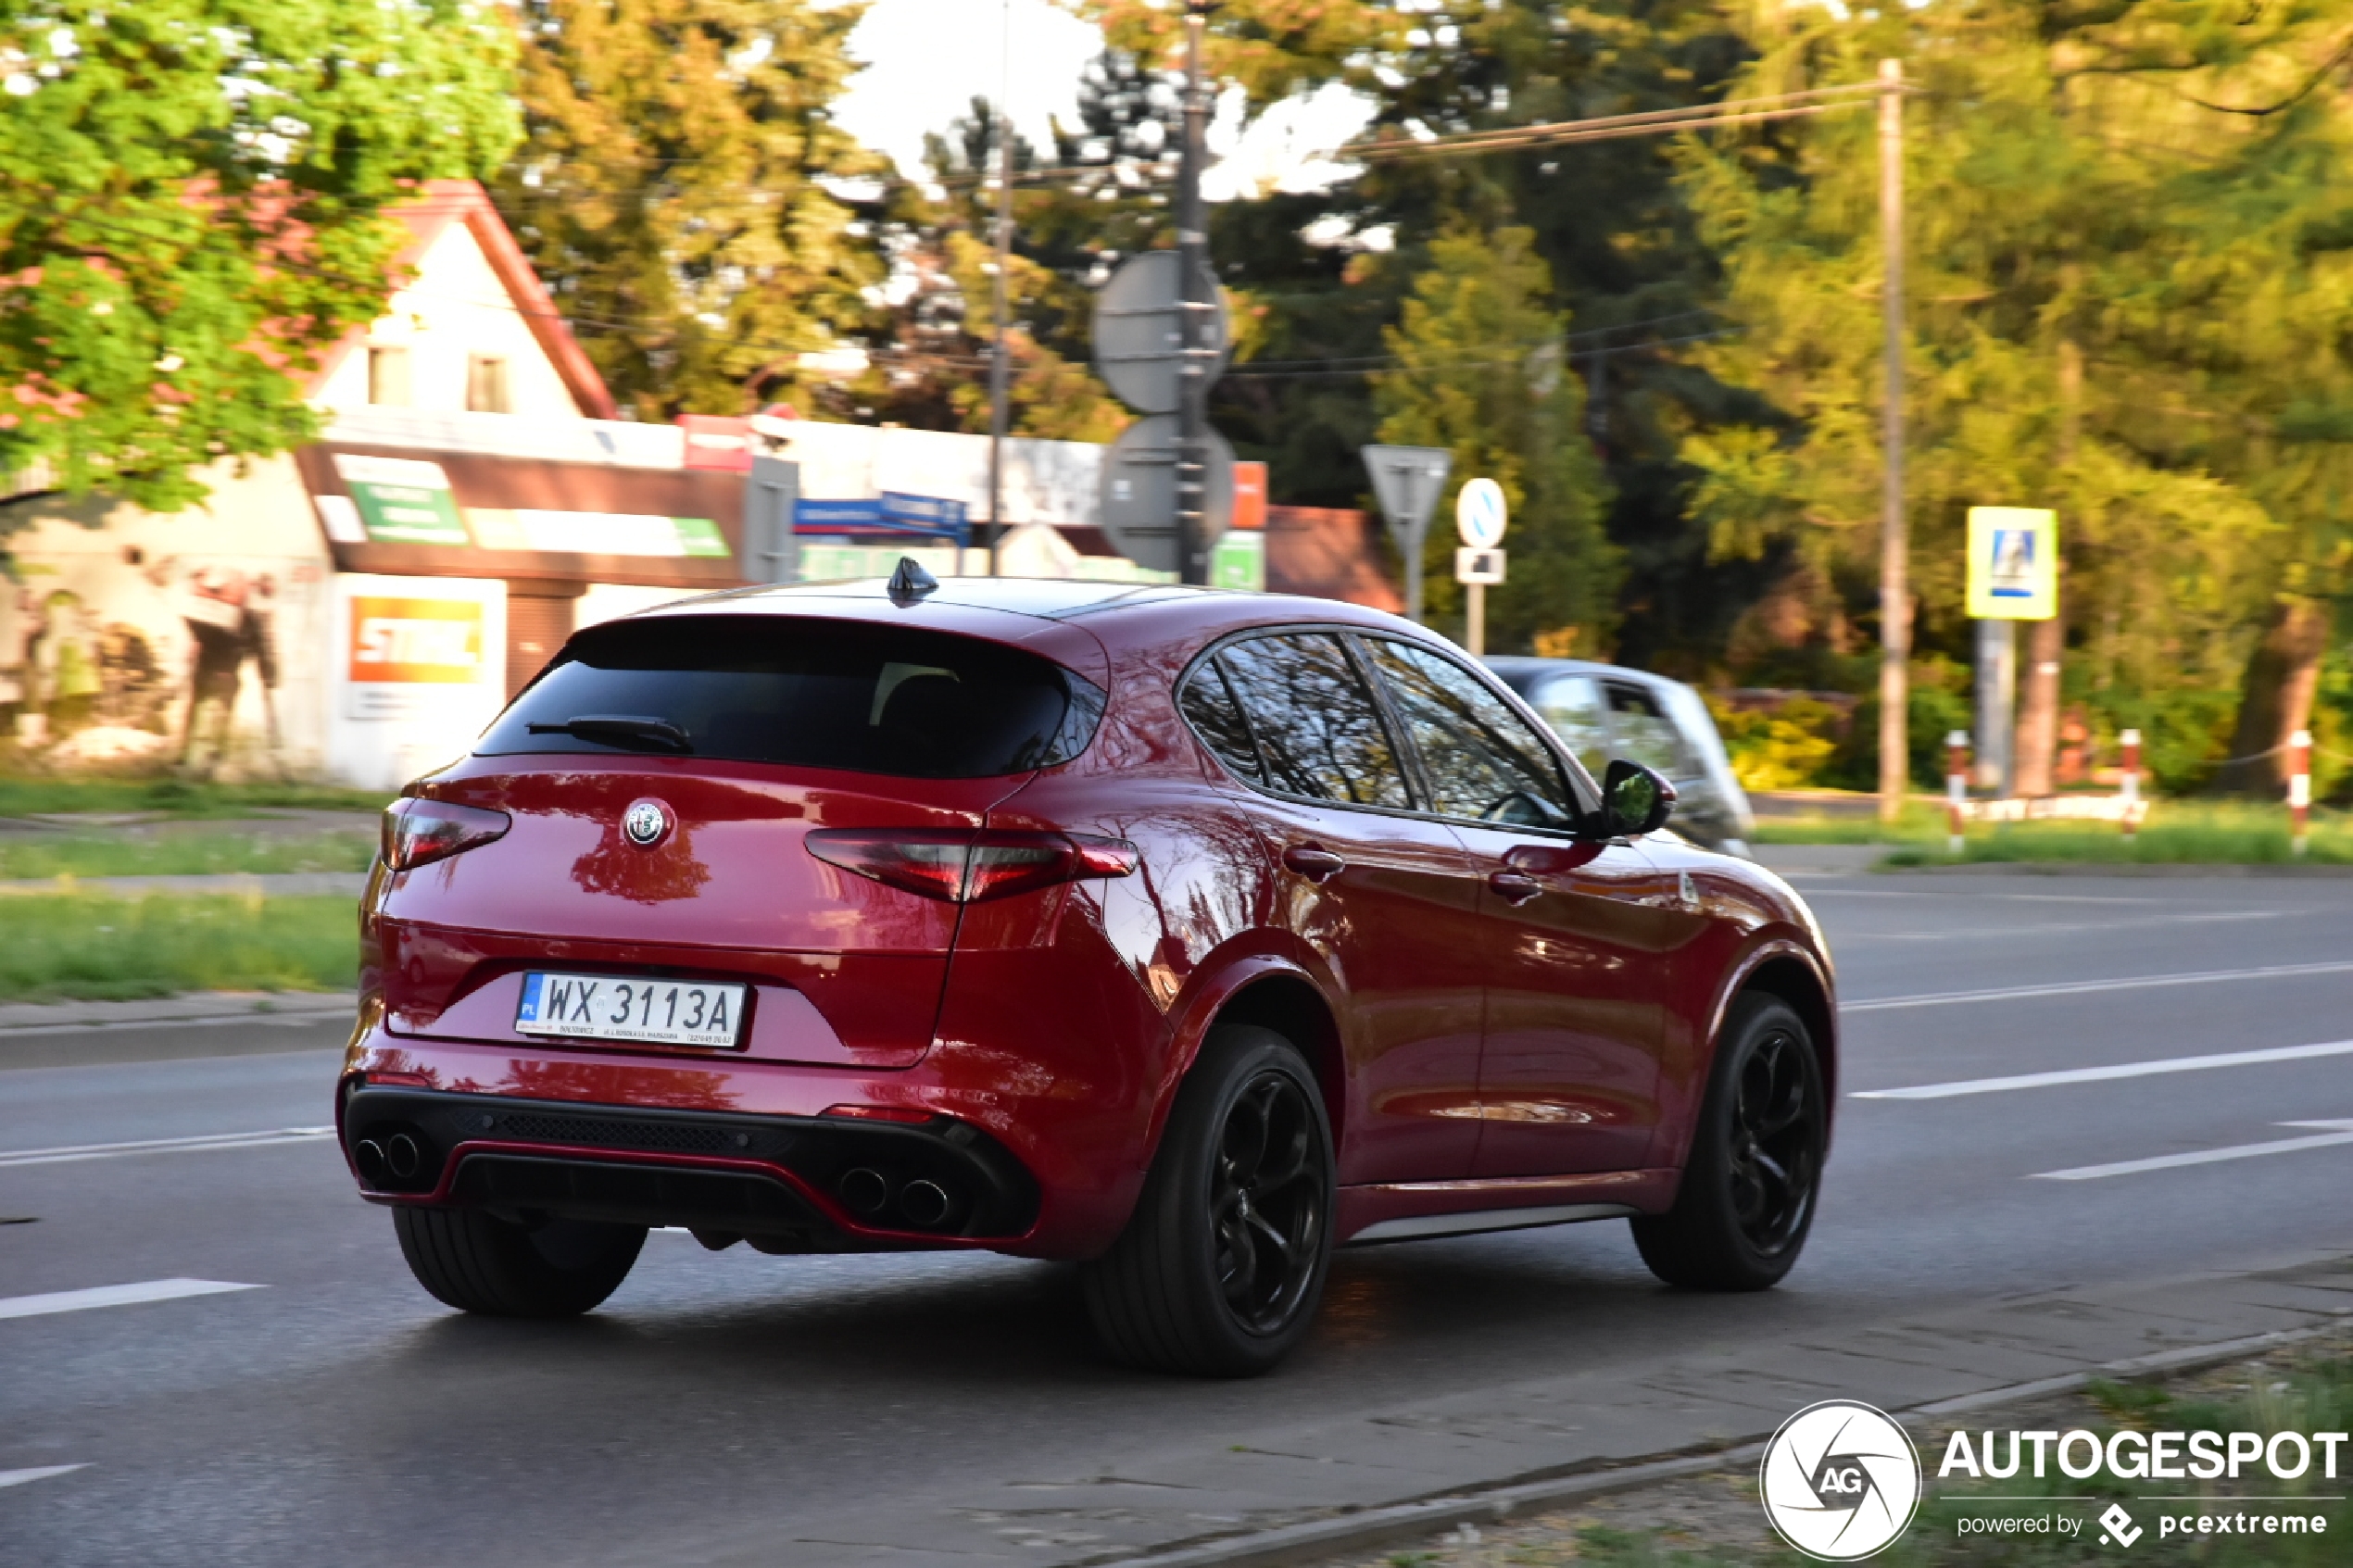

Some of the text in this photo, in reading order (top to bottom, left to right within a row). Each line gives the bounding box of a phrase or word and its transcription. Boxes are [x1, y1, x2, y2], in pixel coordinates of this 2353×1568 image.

[522, 1003, 535, 1016] PL
[547, 979, 727, 1032] WX 3113A
